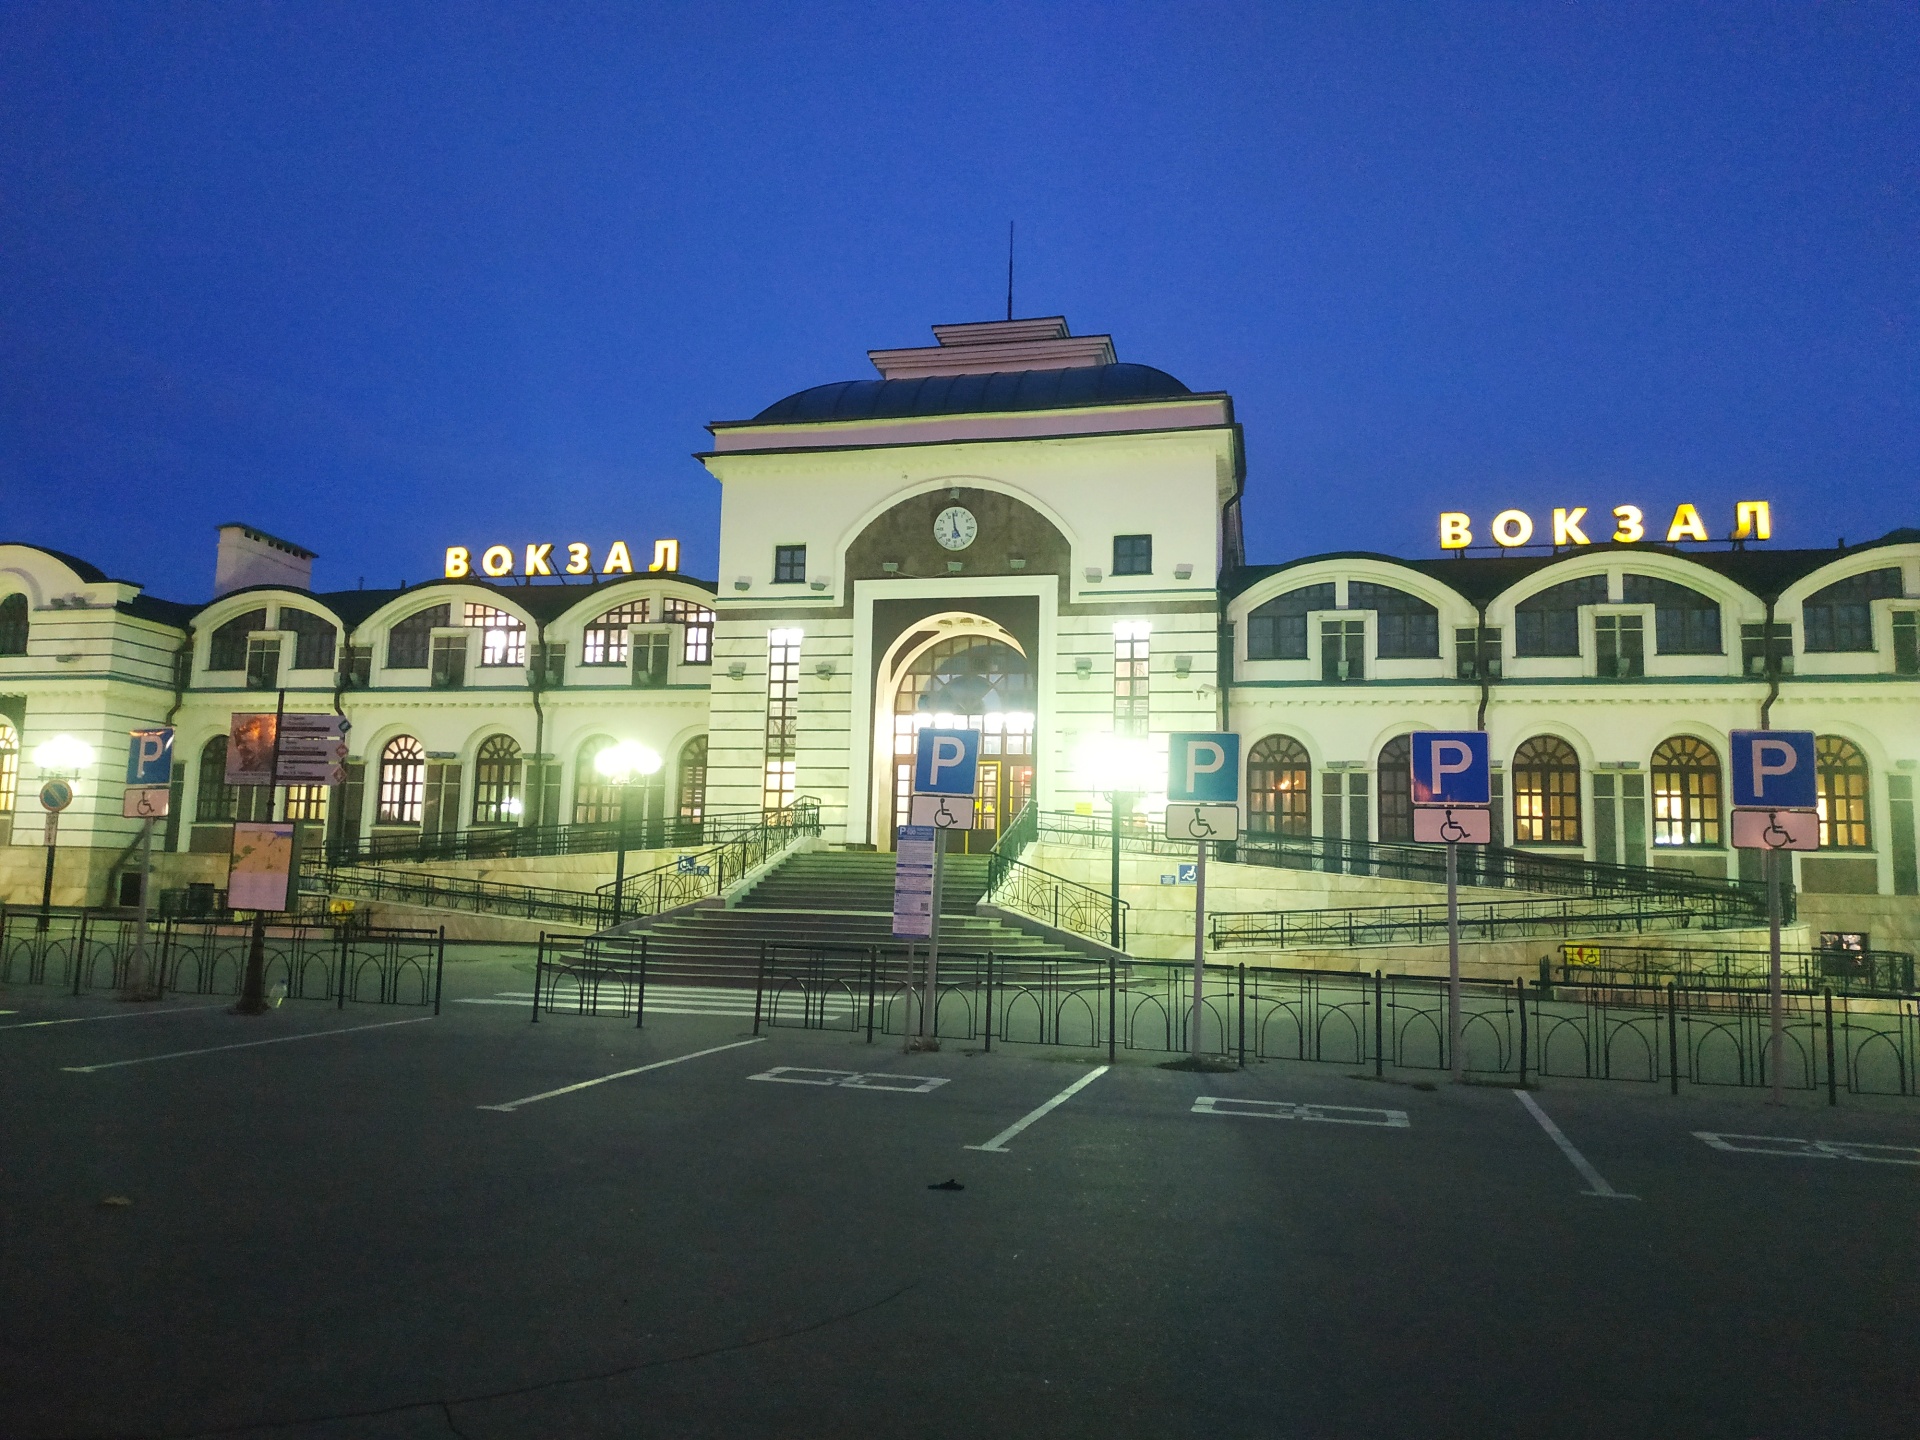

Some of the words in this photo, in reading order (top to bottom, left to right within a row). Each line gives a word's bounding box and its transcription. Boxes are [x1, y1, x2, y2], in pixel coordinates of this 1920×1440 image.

[1440, 501, 1771, 549] ВОКЗАЛ
[445, 539, 679, 578] ВОКЗАЛ
[137, 734, 163, 778] P
[930, 736, 965, 785] P
[1186, 741, 1225, 793] P
[1431, 740, 1473, 794] P
[1752, 740, 1797, 798] P
